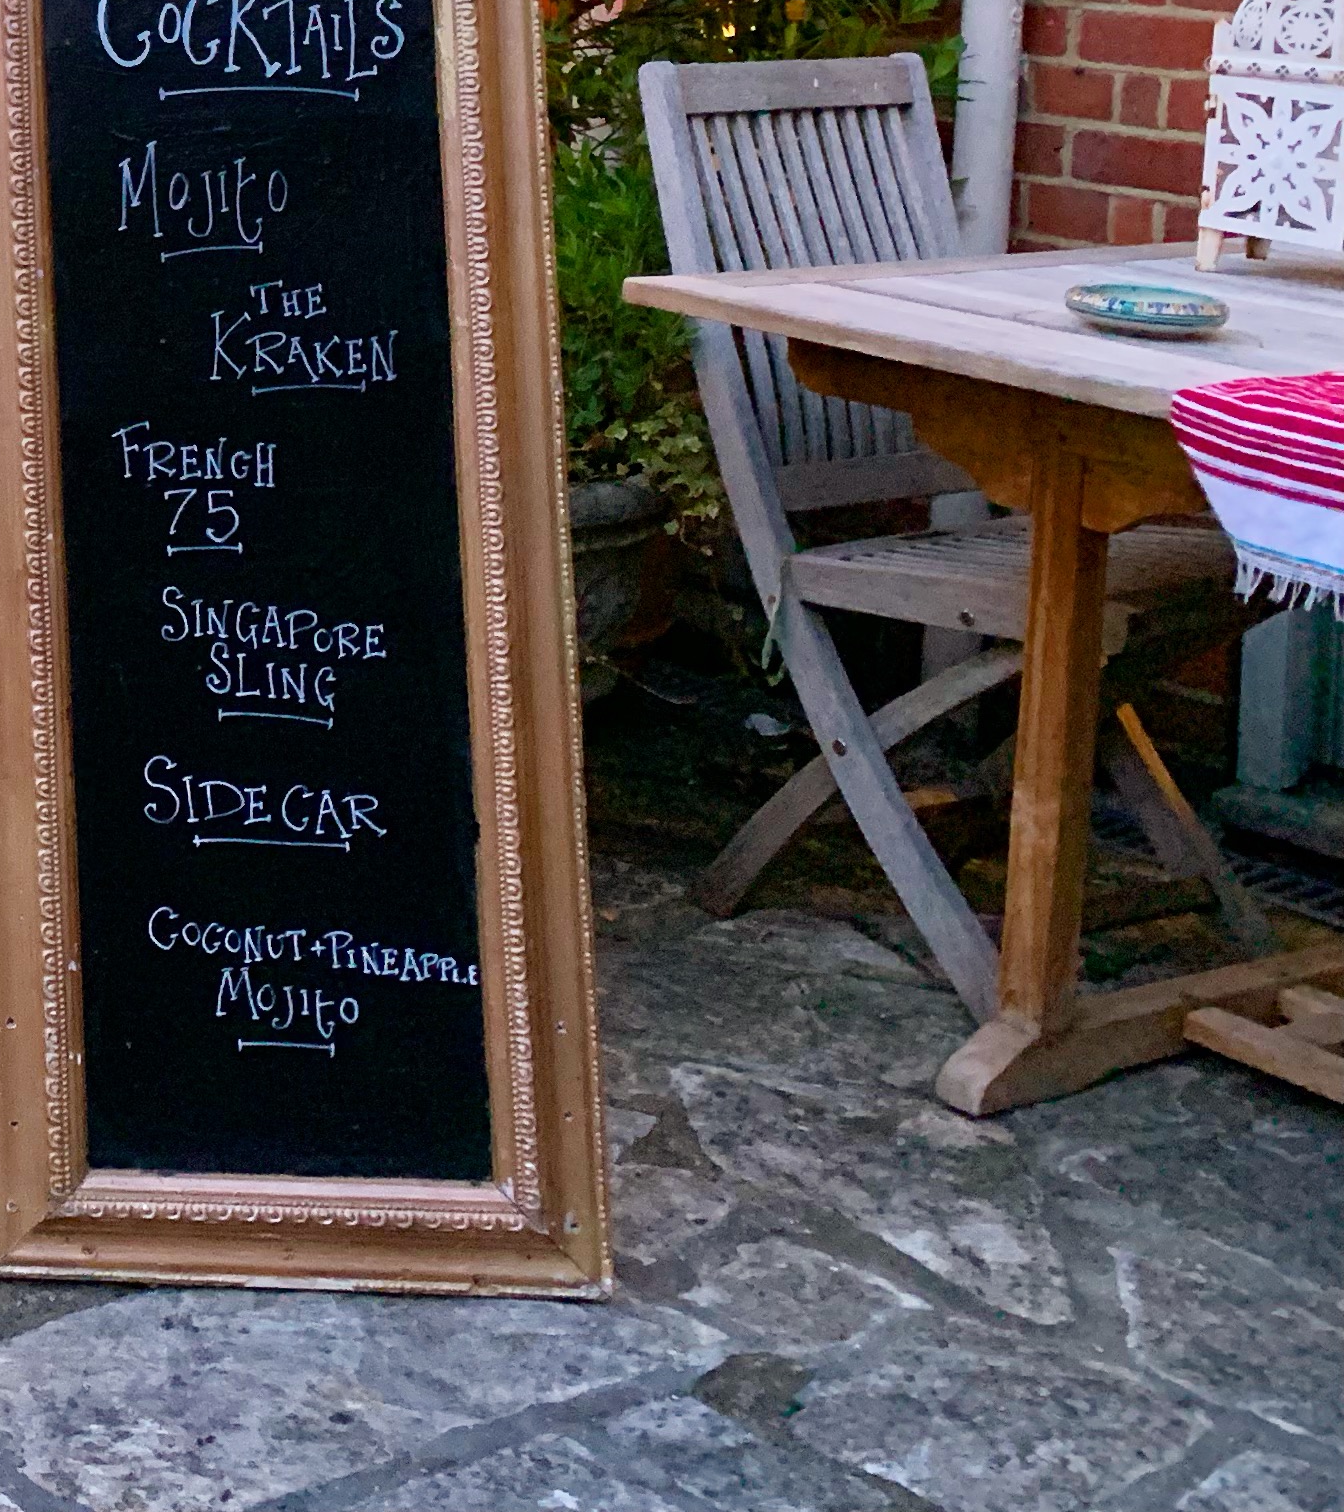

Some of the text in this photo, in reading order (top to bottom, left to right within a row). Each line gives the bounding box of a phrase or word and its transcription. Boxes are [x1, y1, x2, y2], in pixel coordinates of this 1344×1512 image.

[249, 279, 328, 320] THE
[209, 310, 398, 384] KRAKEN
[111, 420, 277, 488] FRENCH
[162, 488, 241, 544] 75
[161, 585, 388, 660] SINGAPORE
[205, 640, 337, 712] SLING
